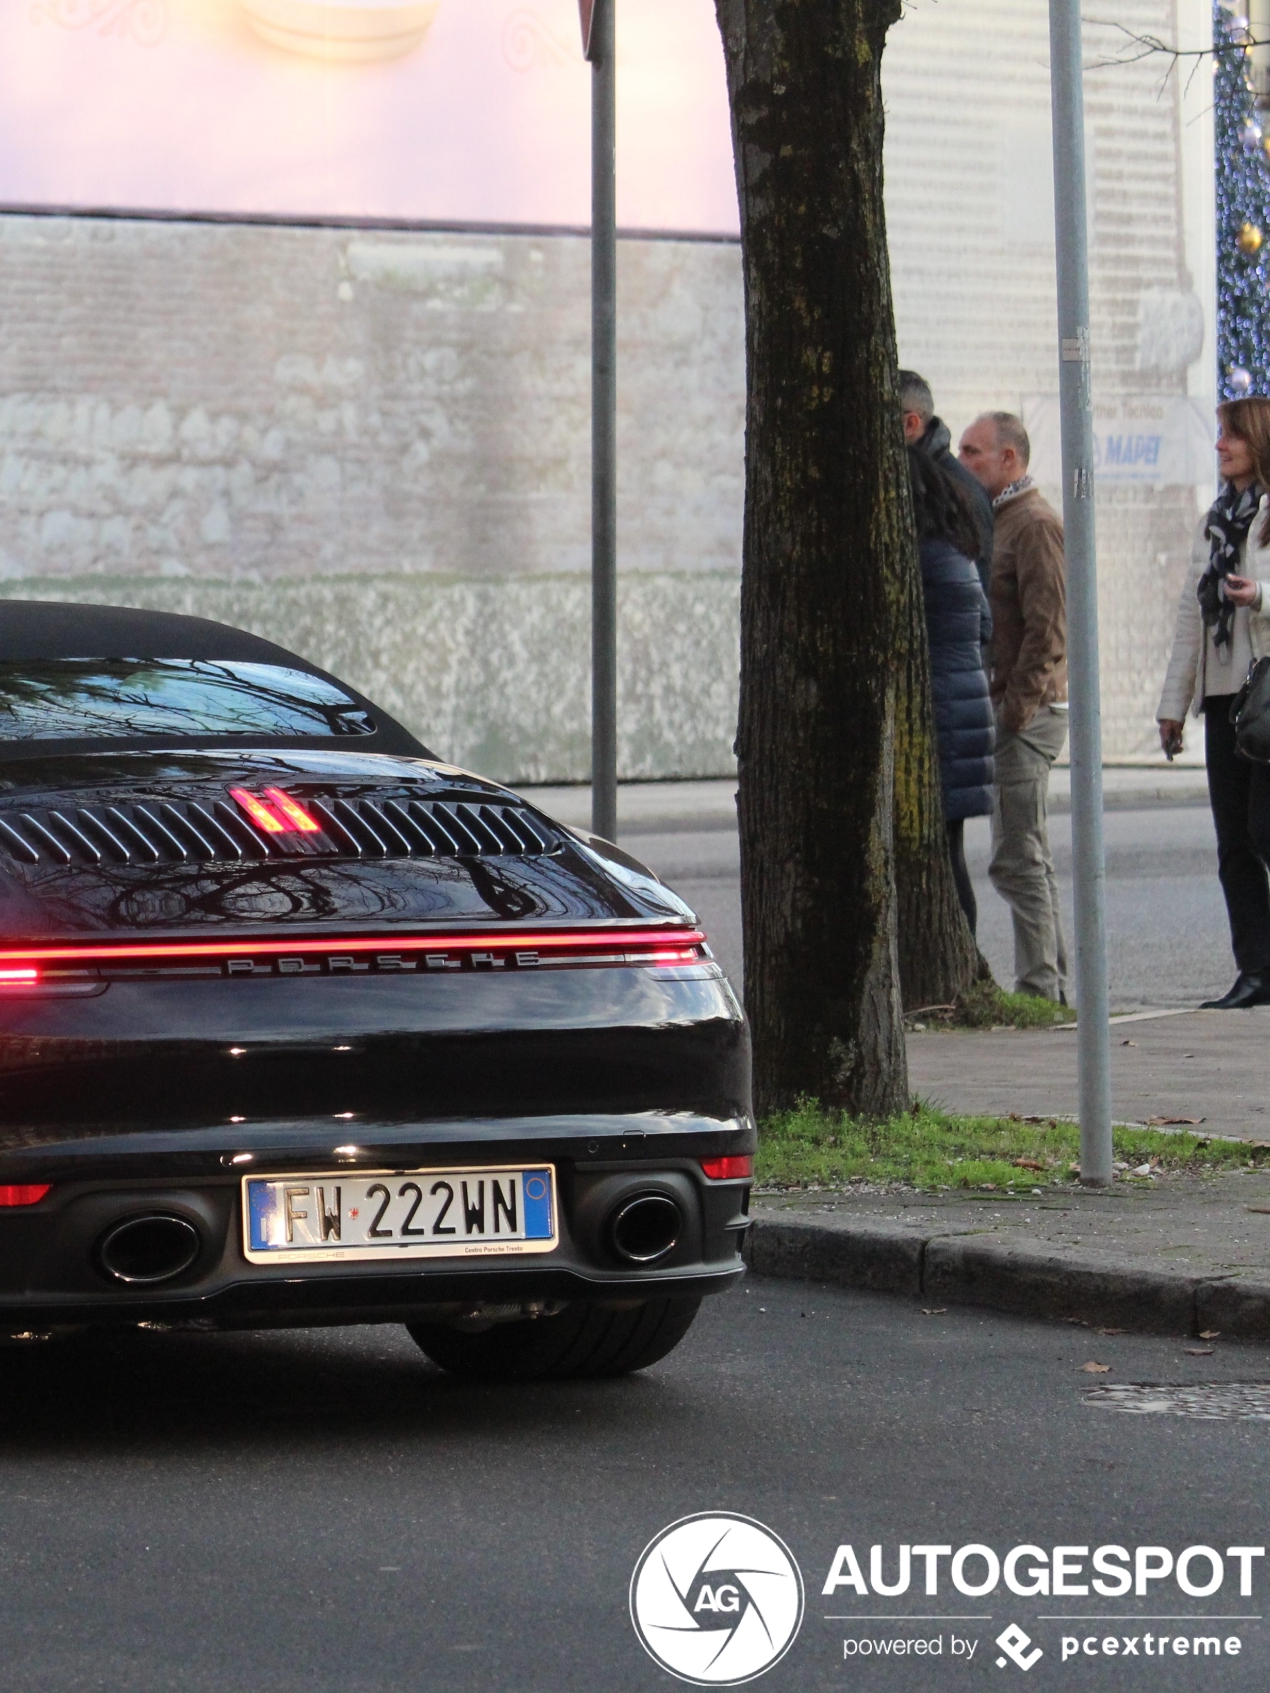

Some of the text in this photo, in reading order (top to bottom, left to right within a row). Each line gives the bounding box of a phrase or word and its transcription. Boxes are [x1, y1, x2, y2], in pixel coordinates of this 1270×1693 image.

[1104, 435, 1161, 466] MAPEI
[227, 952, 540, 975] PORSCHE
[284, 1179, 518, 1242] FW 222WN
[277, 1251, 345, 1260] PORSCHE
[464, 1246, 483, 1254] Centro
[483, 1245, 505, 1253] Porsche
